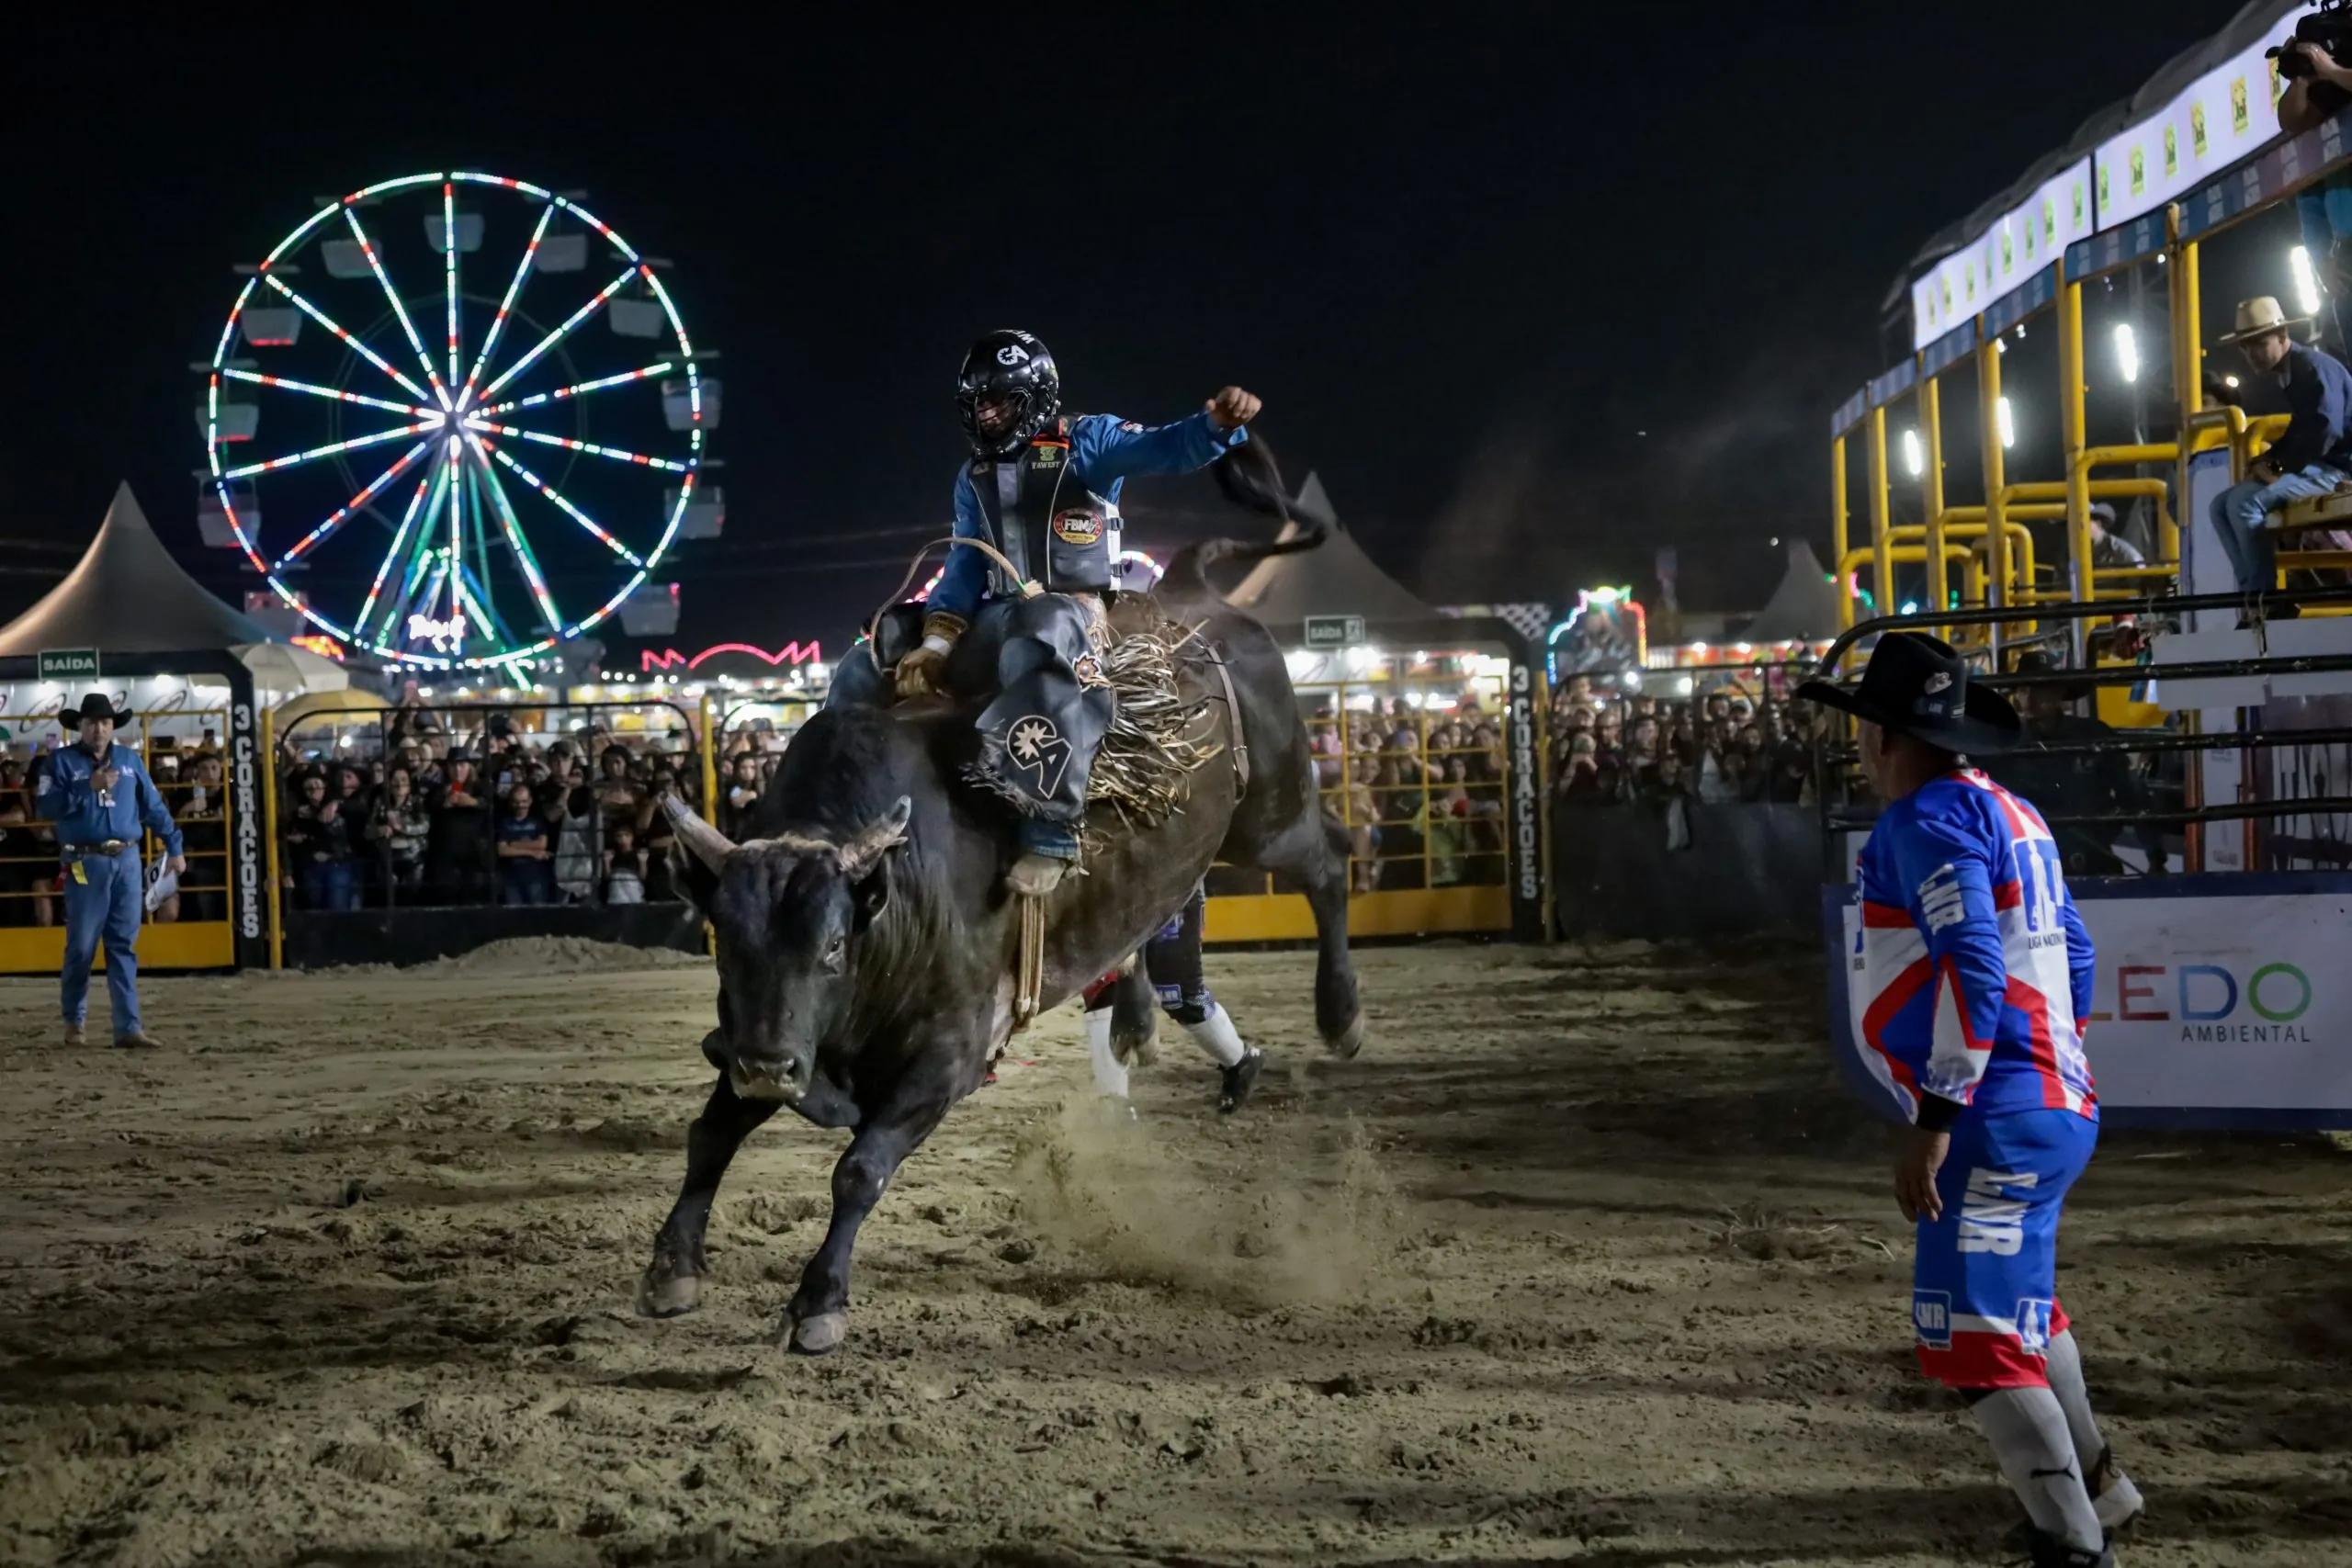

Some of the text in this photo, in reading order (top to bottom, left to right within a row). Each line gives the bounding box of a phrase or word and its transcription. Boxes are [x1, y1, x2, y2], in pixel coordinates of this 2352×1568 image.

[1032, 461, 1061, 469] FAWEST
[43, 656, 95, 671] SAÍDA
[1513, 665, 1530, 693] 3
[234, 704, 251, 730] 3
[2181, 1024, 2312, 1043] AMBIENTAL
